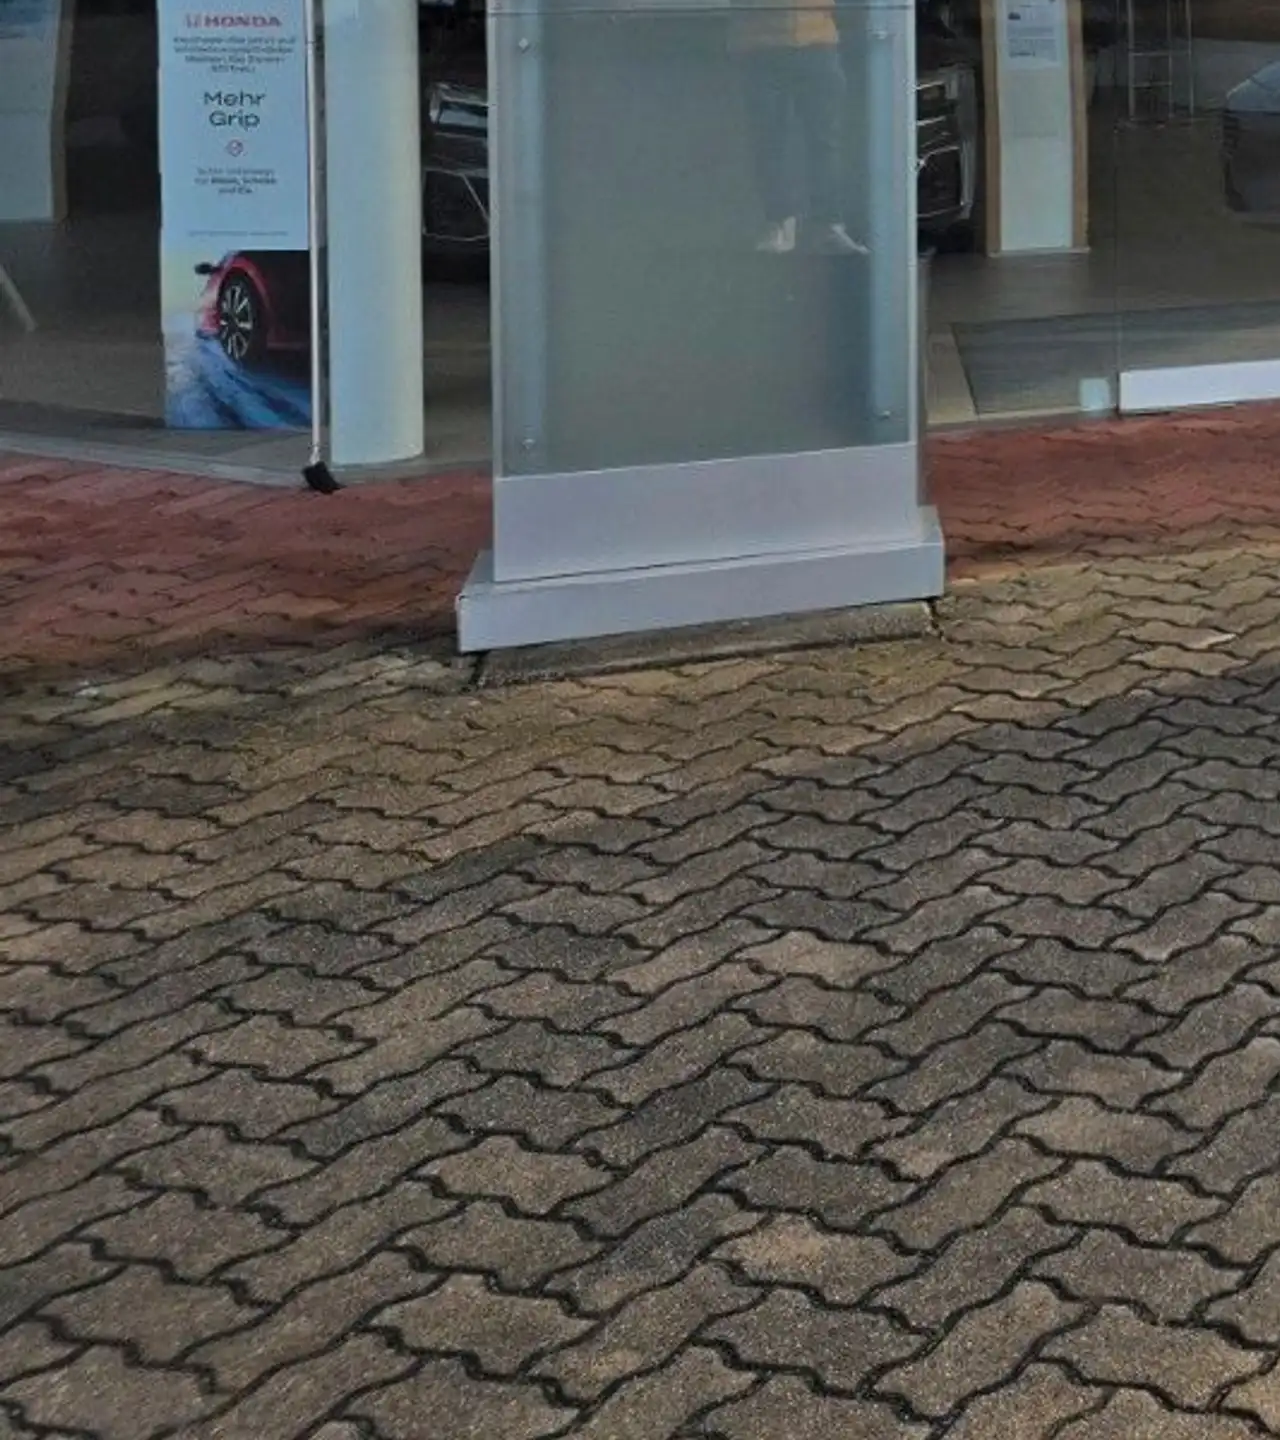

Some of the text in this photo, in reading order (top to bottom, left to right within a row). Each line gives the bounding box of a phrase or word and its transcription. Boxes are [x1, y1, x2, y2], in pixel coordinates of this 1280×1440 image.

[204, 15, 282, 28] HONDA
[204, 90, 266, 107] Mehr
[209, 109, 261, 130] Grip
